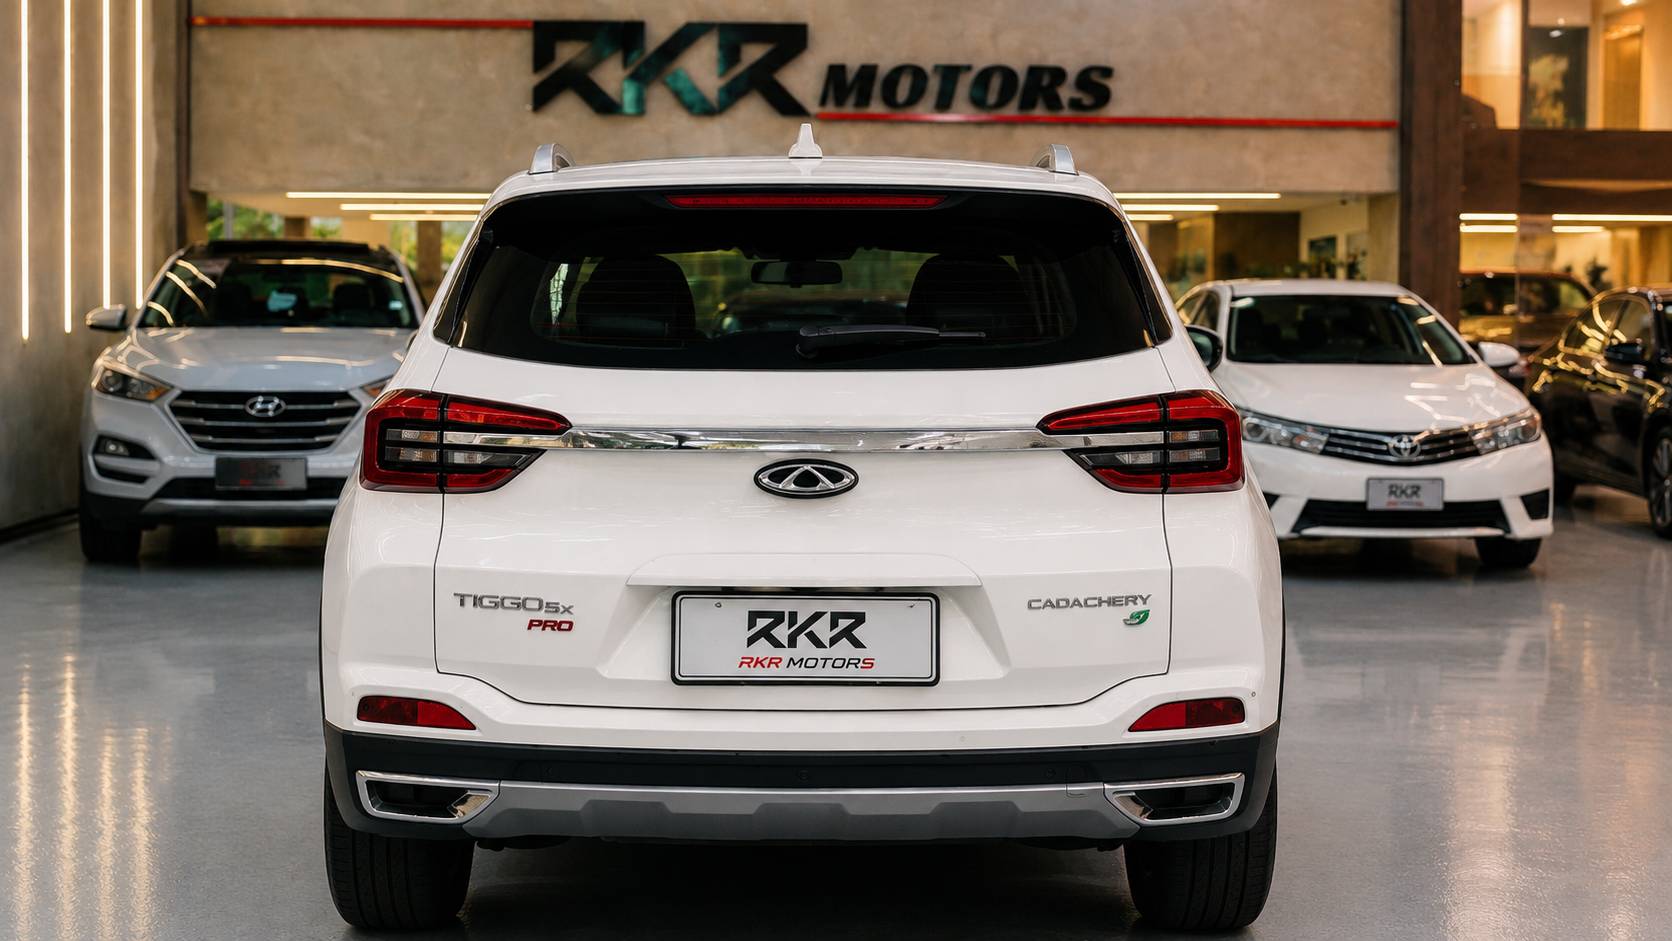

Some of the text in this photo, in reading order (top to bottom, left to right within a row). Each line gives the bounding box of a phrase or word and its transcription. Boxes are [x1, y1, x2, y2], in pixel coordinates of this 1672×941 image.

[533, 21, 1113, 116] RKR MOTORS
[1027, 594, 1152, 610] CADACHERY
[527, 619, 574, 632] PRO
[746, 610, 867, 649] RKR
[738, 656, 875, 669] RKR MOTORS
